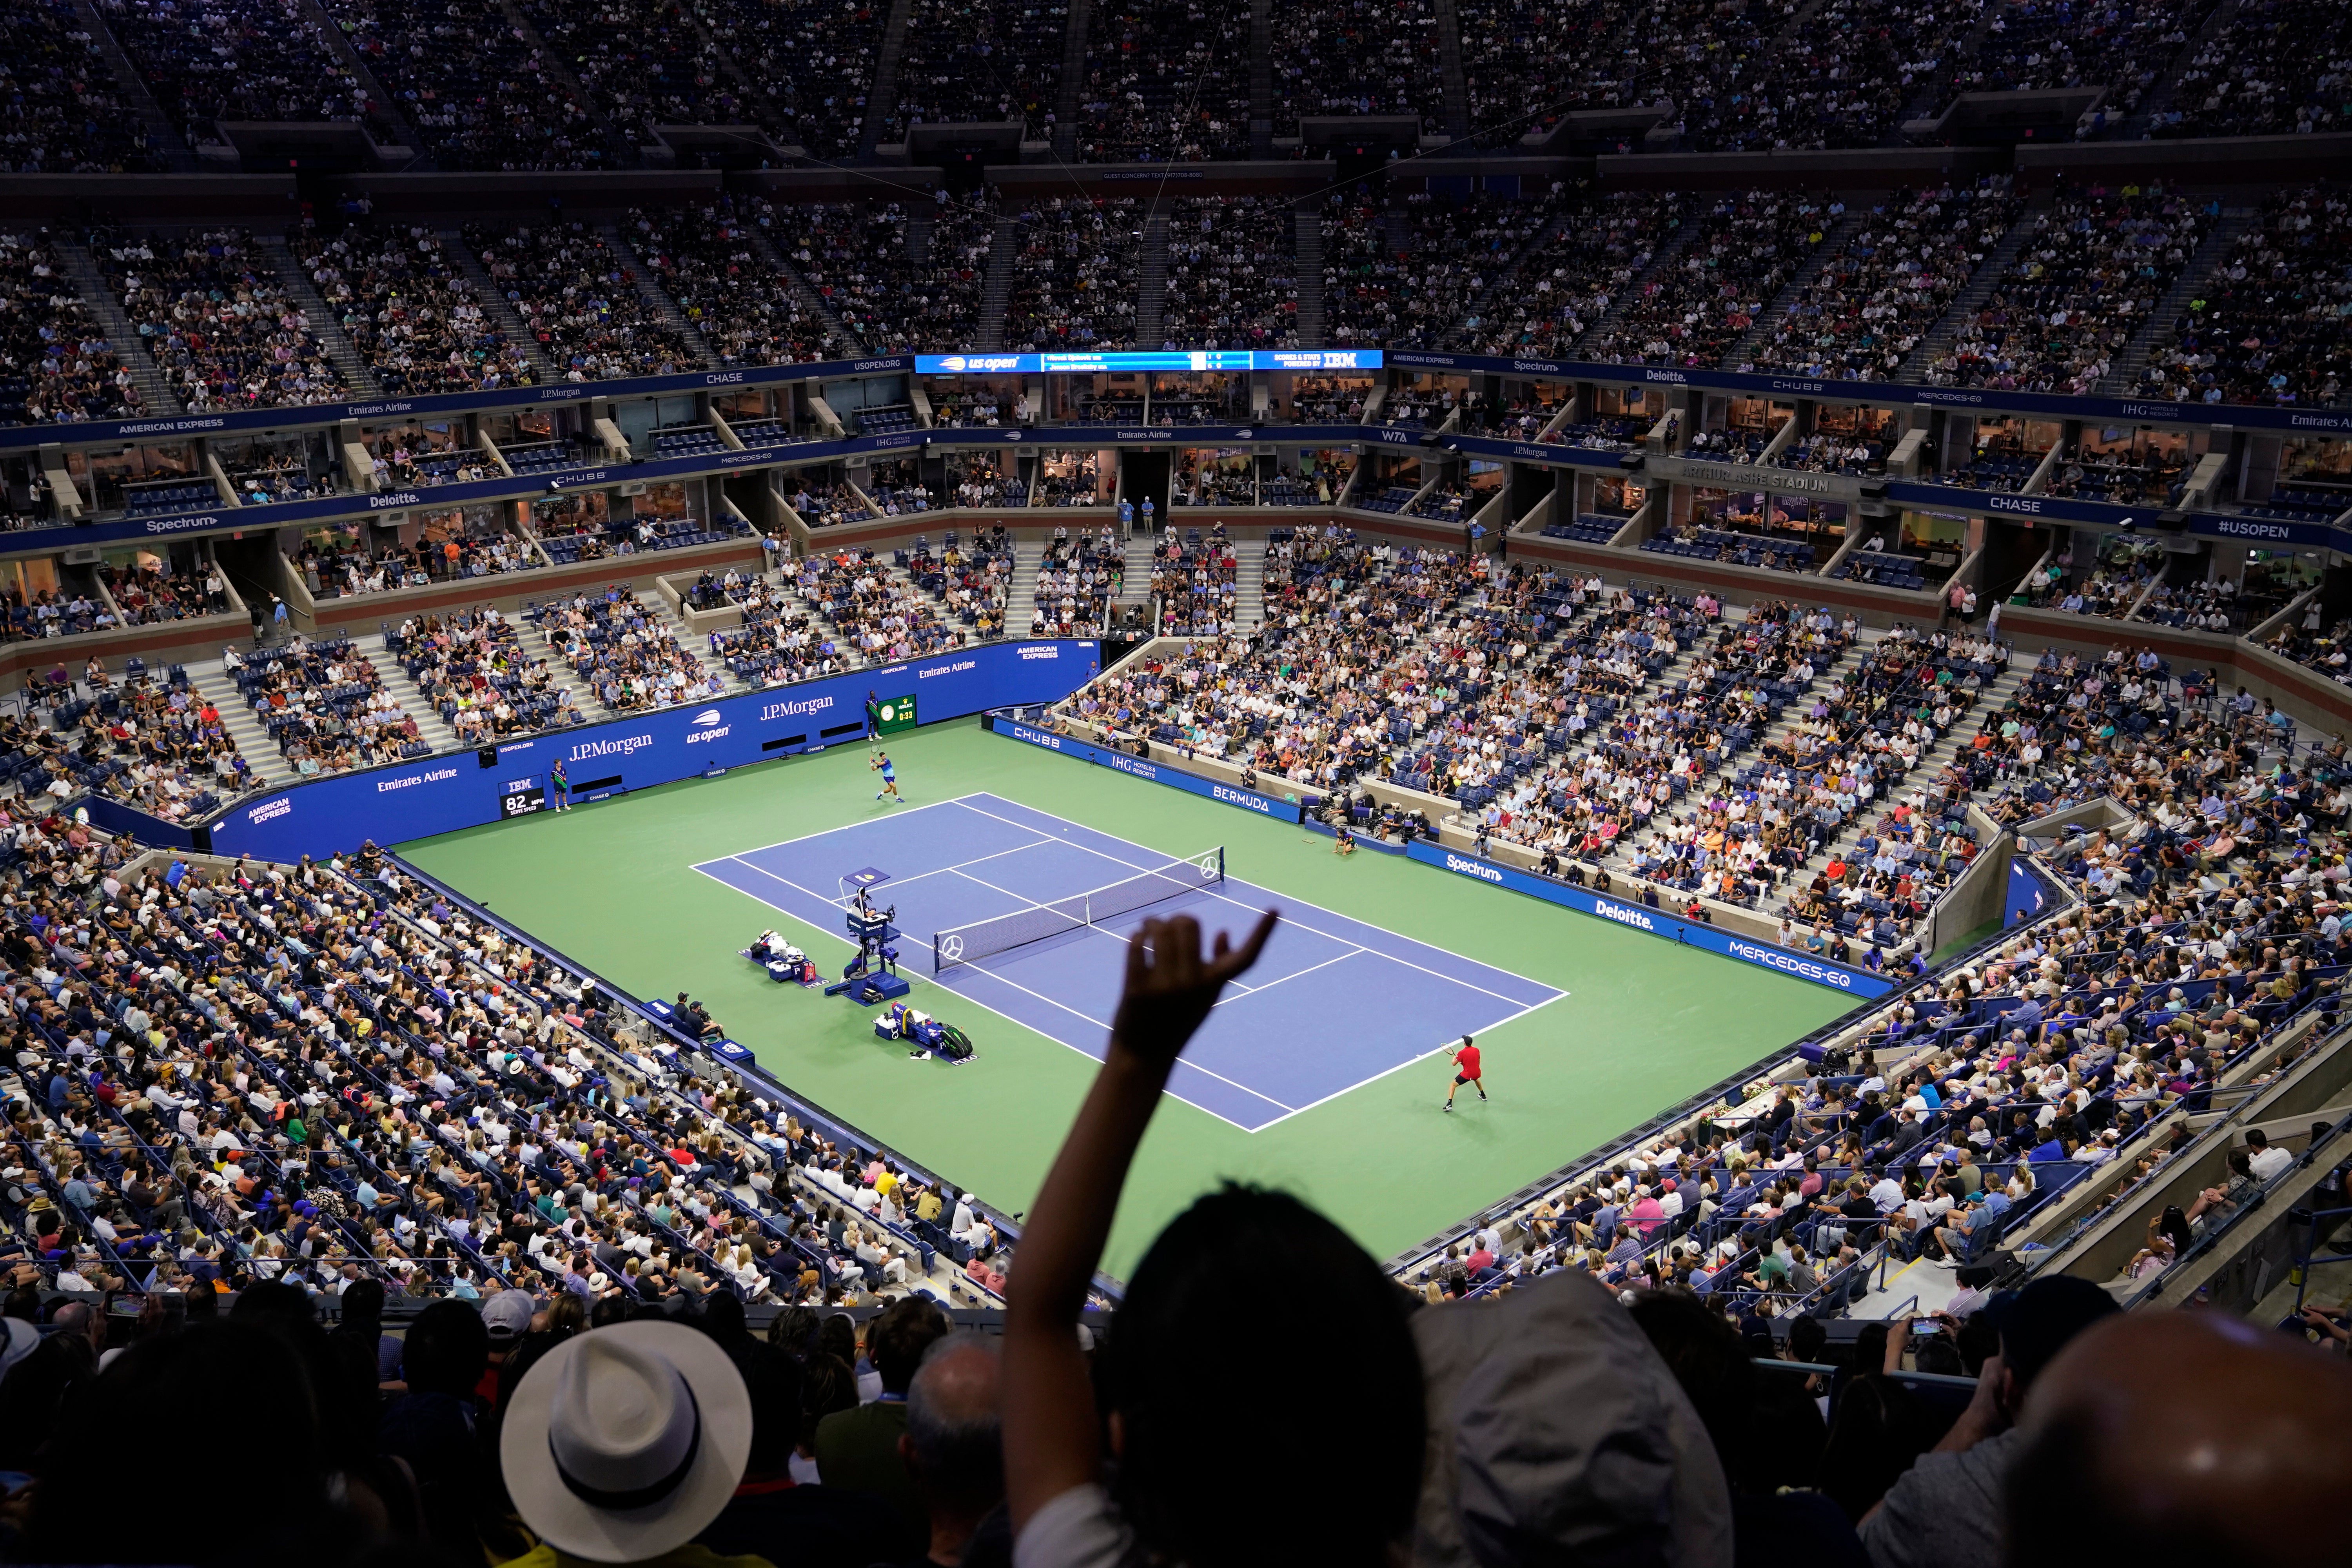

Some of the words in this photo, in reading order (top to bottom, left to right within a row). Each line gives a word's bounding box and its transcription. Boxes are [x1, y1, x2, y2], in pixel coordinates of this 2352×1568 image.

[855, 359, 900, 370] USOPEN.ORG
[969, 358, 983, 369] us
[985, 357, 1017, 371] open
[1324, 353, 1356, 367] IBM
[1514, 360, 1556, 372] Spectrum
[707, 373, 742, 383] CHASE
[1647, 368, 1686, 382] Deloitte.
[1773, 381, 1822, 391] CHUBB
[541, 389, 580, 398] J.P.Morgan
[1918, 392, 1982, 402] MERCEDES-EQ
[348, 406, 383, 415] Emirates
[385, 403, 412, 412] Airline
[2123, 404, 2147, 415] IHG
[120, 423, 174, 433] AMERICAN
[177, 419, 223, 429] EXPRESS
[2292, 415, 2338, 427] Emirates
[877, 438, 892, 446] IHG
[1382, 431, 1406, 442] WTA
[722, 453, 771, 463] MERCEDES-EQ
[1514, 446, 1546, 458] J.P.Morgan
[556, 472, 604, 483] CHUBB
[1683, 466, 1730, 481] ARTHUR
[1734, 472, 1768, 485] ASHE
[1771, 475, 1829, 492] STADIUM
[370, 493, 419, 507] Deloitte.
[1991, 497, 2040, 512] CHASE
[146, 516, 214, 533] Spectrum
[2219, 521, 2288, 538] #USOPEN
[882, 666, 907, 674] USOPEN.ORG
[919, 666, 950, 678] Emirates
[952, 661, 975, 672] Airline
[760, 697, 833, 720] J.P.Morgan
[687, 732, 700, 744] us
[702, 727, 728, 743] open
[1015, 728, 1059, 748] CHUBB
[500, 742, 533, 752] USOPEN.ORG
[570, 735, 652, 761] J.P.Morgan
[1112, 755, 1131, 771] IHG
[1133, 762, 1152, 771] HOTELS
[377, 777, 421, 791] Emirates
[424, 769, 457, 782] Airline
[1133, 768, 1155, 778] RESORTS
[508, 779, 532, 793] IBM
[506, 795, 526, 810] 82
[1214, 786, 1270, 811] BERMUDA
[249, 798, 289, 819] AMERICAN
[254, 805, 290, 824] EXPRESS
[213, 822, 225, 831] USTA
[1447, 854, 1499, 881] Spectrum
[1596, 900, 1653, 930] Deloitte.
[1730, 941, 1850, 987] MERCEDES-EQ
[805, 980, 830, 989] POLO
[951, 1055, 978, 1066] POLO
